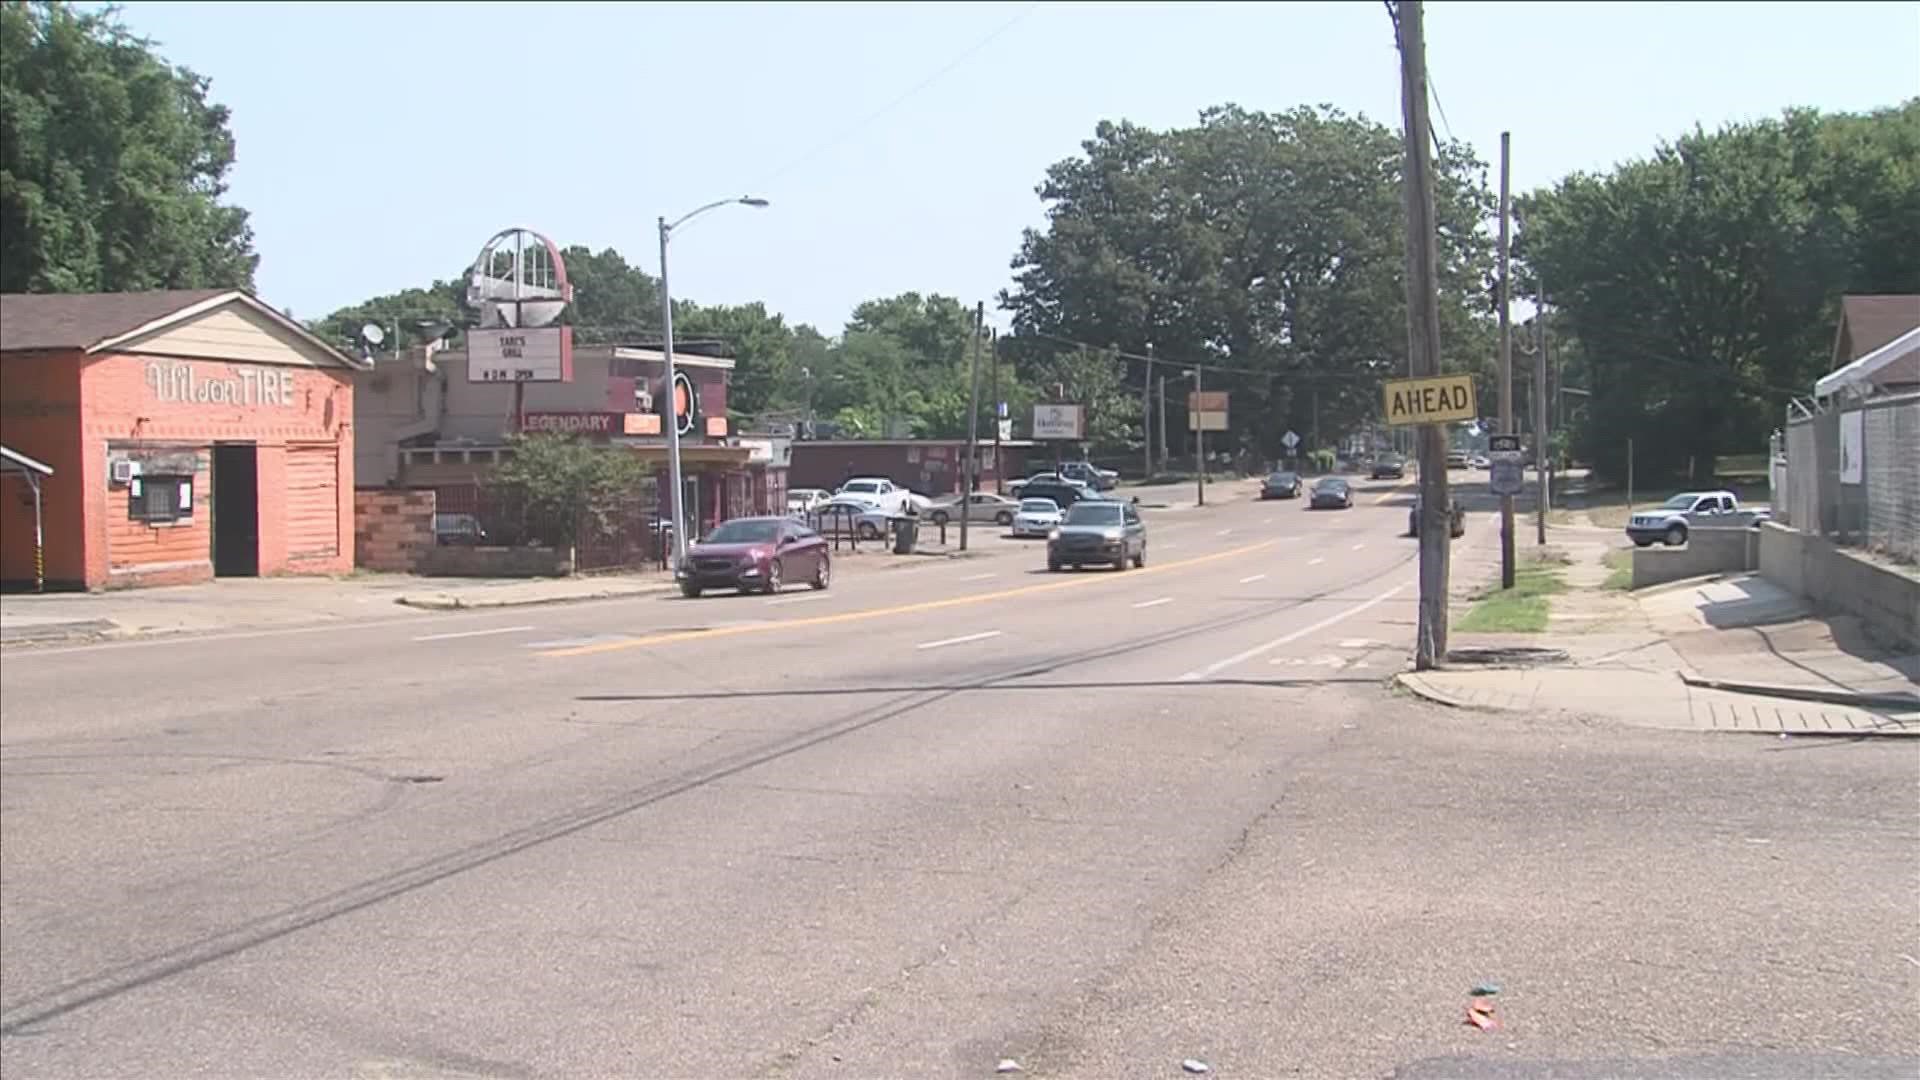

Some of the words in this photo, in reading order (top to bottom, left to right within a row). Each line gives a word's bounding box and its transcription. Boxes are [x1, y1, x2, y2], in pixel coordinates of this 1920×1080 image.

[239, 368, 294, 407] TIRE
[1392, 384, 1468, 416] AHEAD
[521, 415, 611, 432] LEGENDARY
